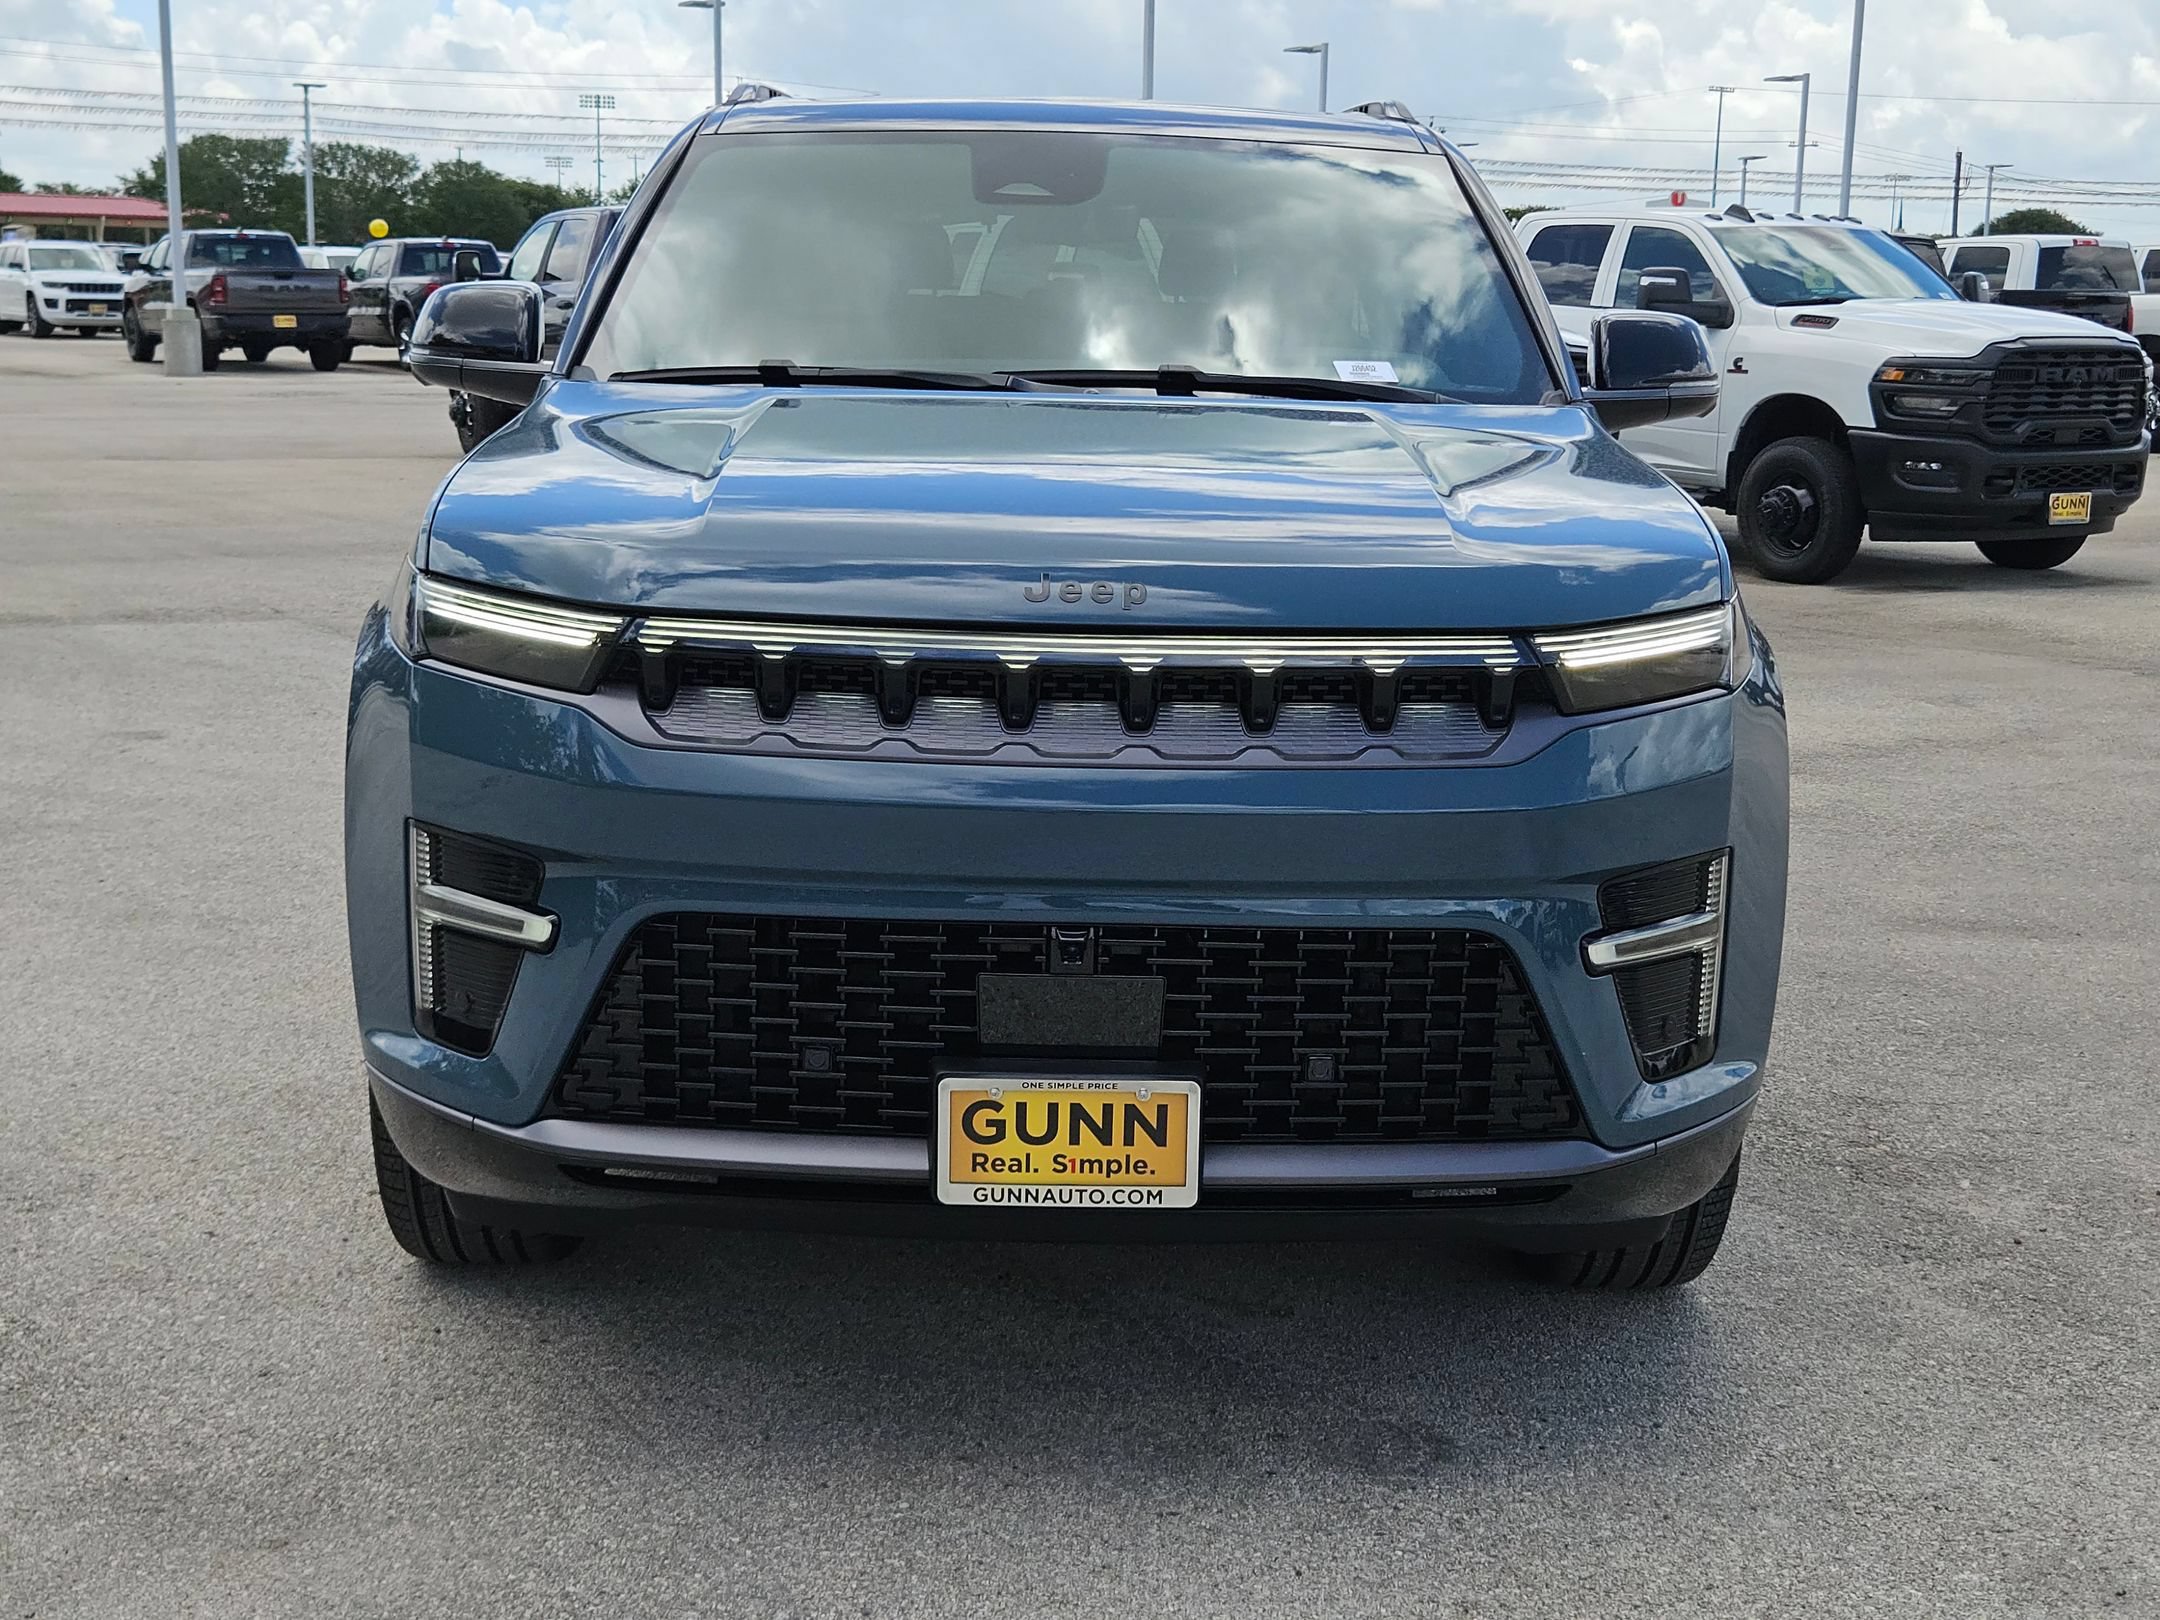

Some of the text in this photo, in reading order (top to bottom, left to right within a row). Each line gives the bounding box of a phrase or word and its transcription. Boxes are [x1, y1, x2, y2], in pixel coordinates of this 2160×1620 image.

[2039, 367, 2115, 383] RAM
[2052, 496, 2086, 510] GUNN
[1023, 572, 1148, 610] Jeep
[1021, 1081, 1044, 1089] ONE
[1047, 1082, 1085, 1090] SIMPLE
[961, 1100, 1169, 1147] GUNN
[971, 1153, 1039, 1173] Real.
[973, 1187, 1163, 1205] GUNNAUTO.COM
